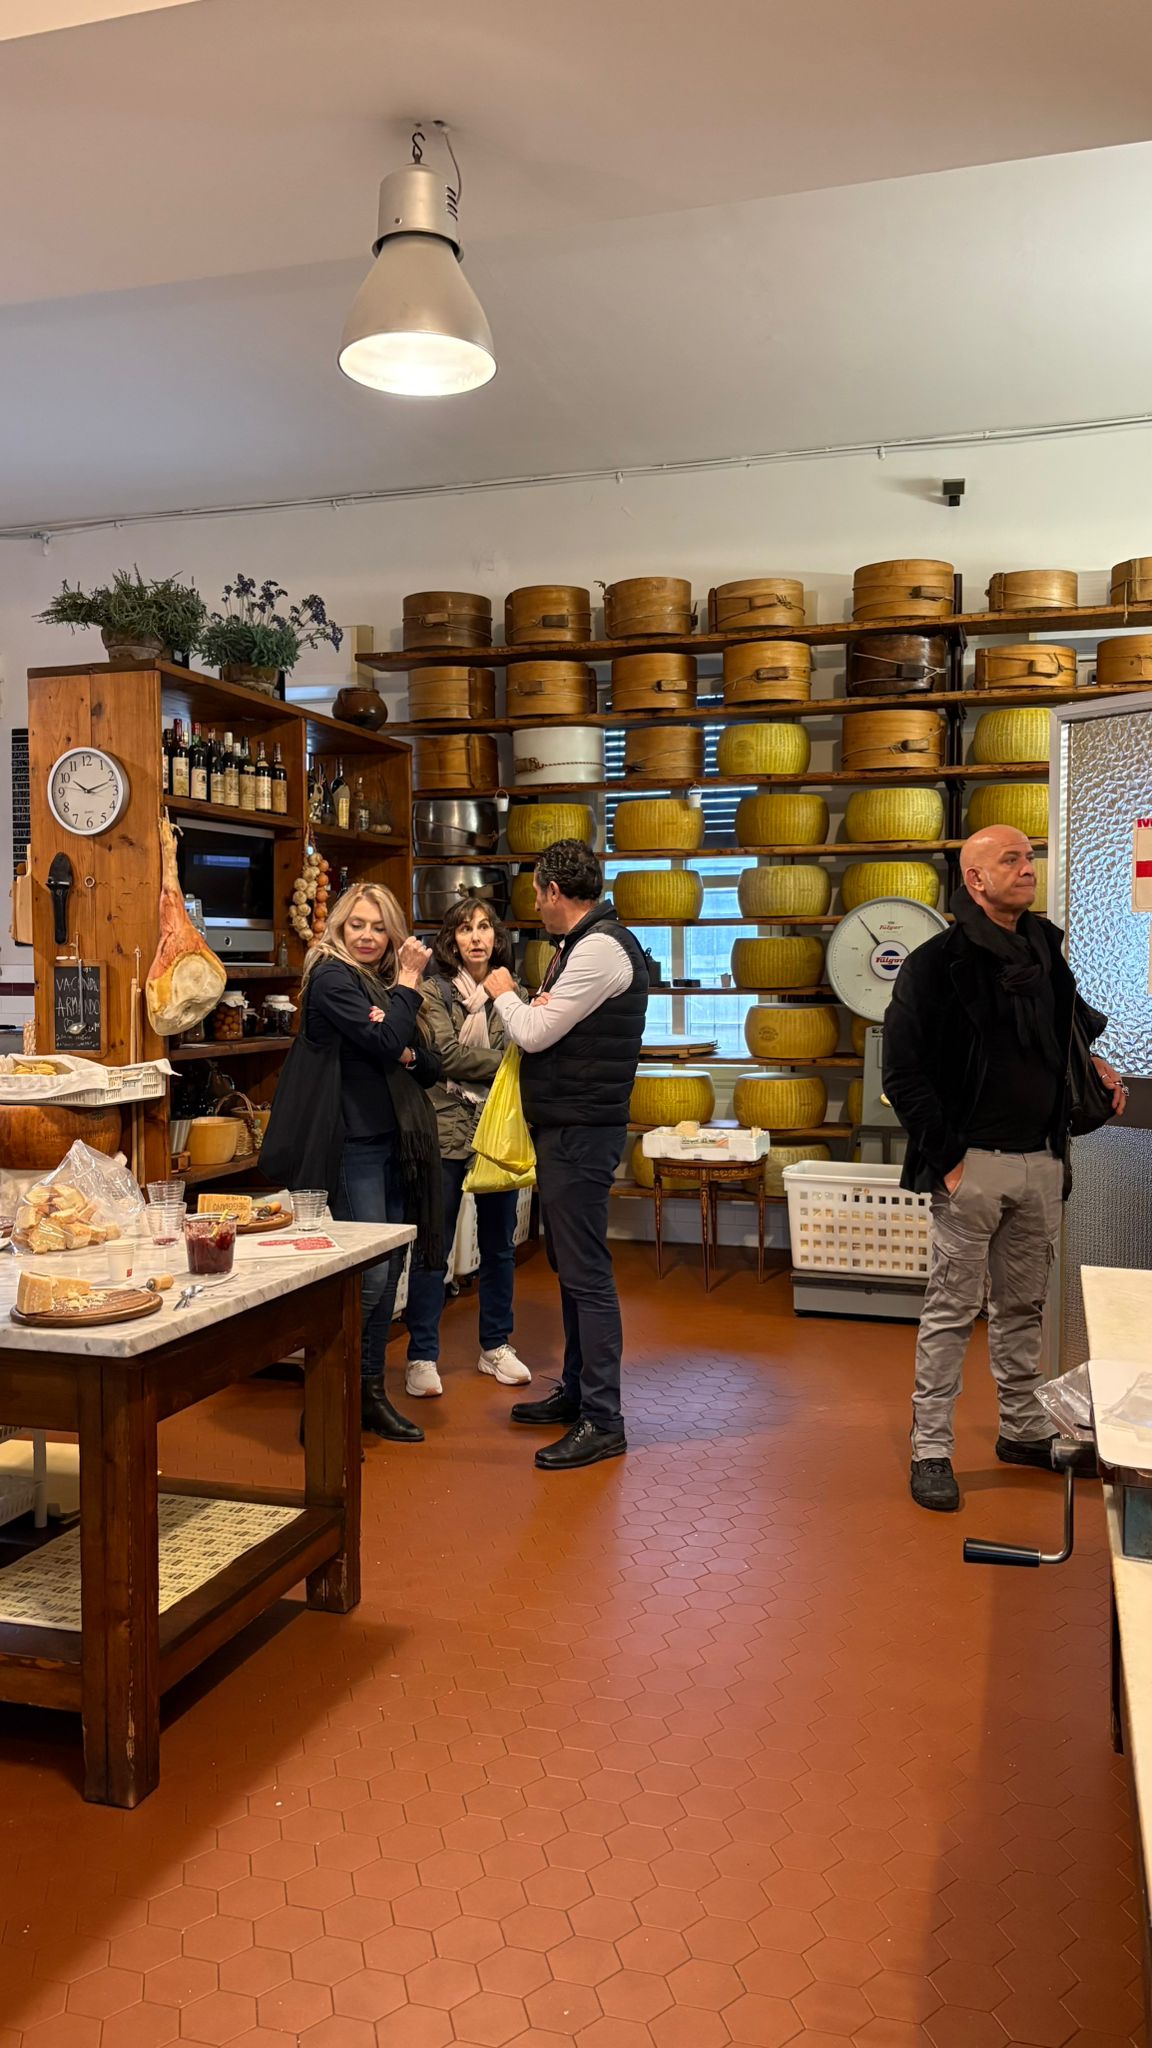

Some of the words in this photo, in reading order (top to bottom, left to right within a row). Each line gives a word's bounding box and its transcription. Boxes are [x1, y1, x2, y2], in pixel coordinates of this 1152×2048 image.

[70, 761, 77, 772] 11
[82, 754, 92, 767] 12
[100, 760, 104, 771] 1
[61, 772, 70, 784] 10
[108, 770, 114, 782] 2
[58, 787, 65, 798] 9
[112, 785, 119, 796] 3
[63, 801, 70, 813] 8
[109, 800, 116, 811] 4
[72, 813, 79, 825] 7
[86, 816, 94, 828] 6
[100, 812, 107, 824] 5
